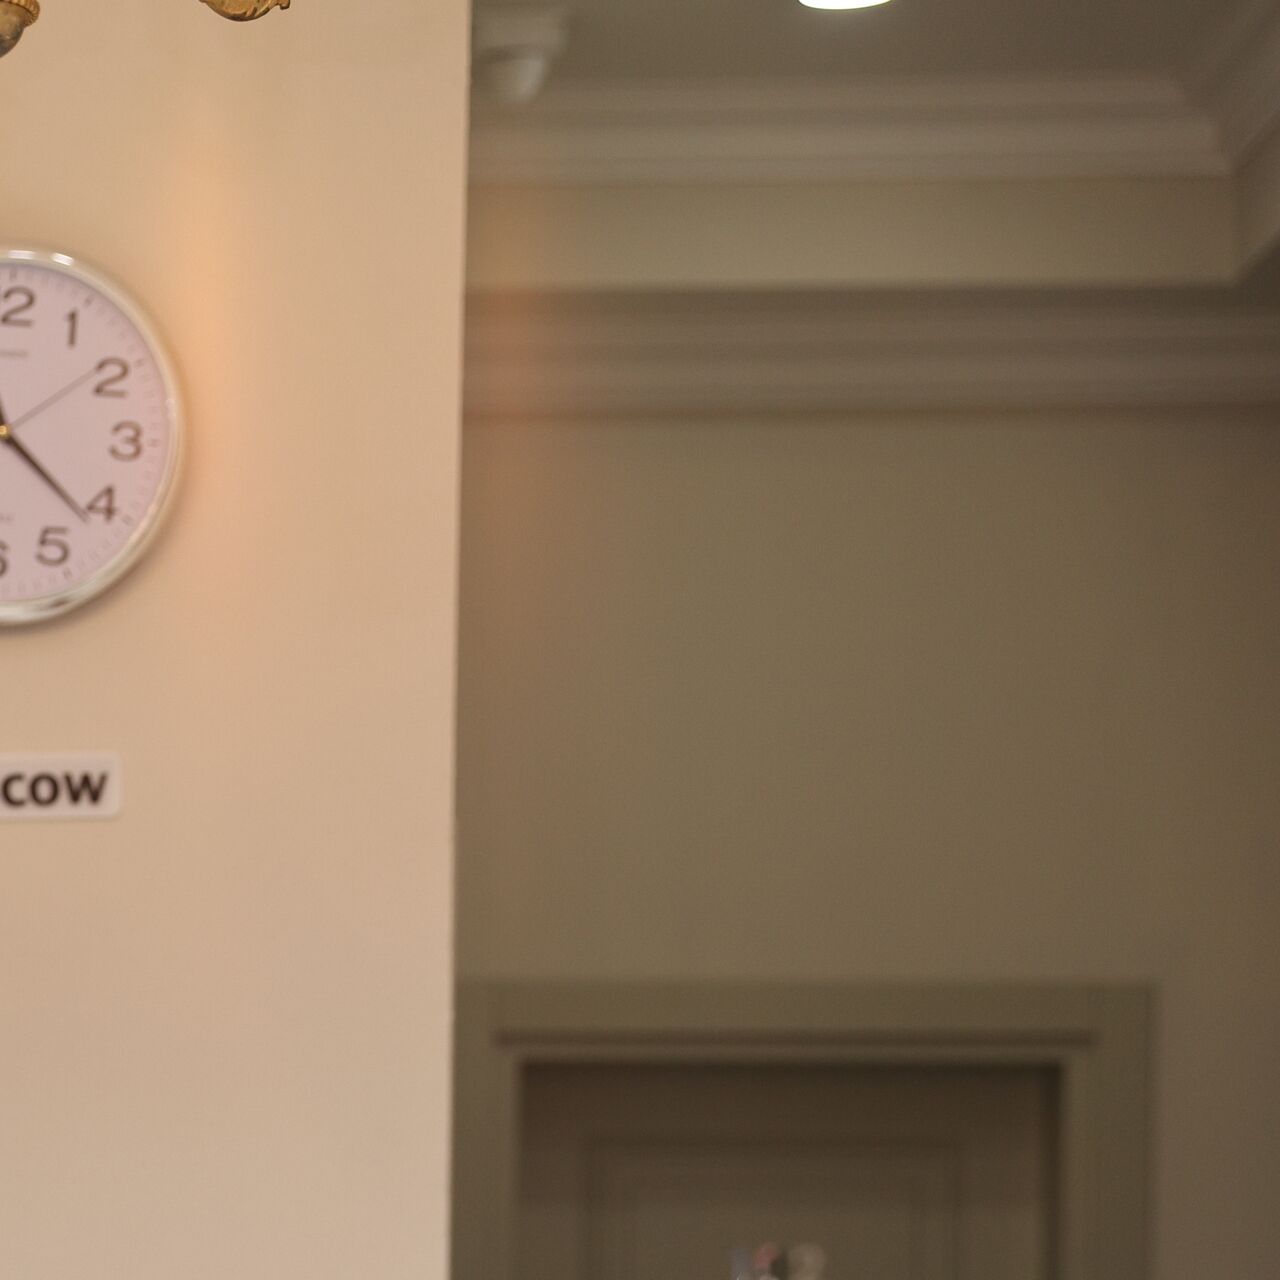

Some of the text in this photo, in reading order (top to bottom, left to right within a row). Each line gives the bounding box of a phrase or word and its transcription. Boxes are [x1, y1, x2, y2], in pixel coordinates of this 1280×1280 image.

[65, 308, 78, 347] 1
[93, 358, 129, 397] 2
[109, 421, 142, 461] 3
[86, 485, 118, 522] 4
[36, 526, 70, 566] 5
